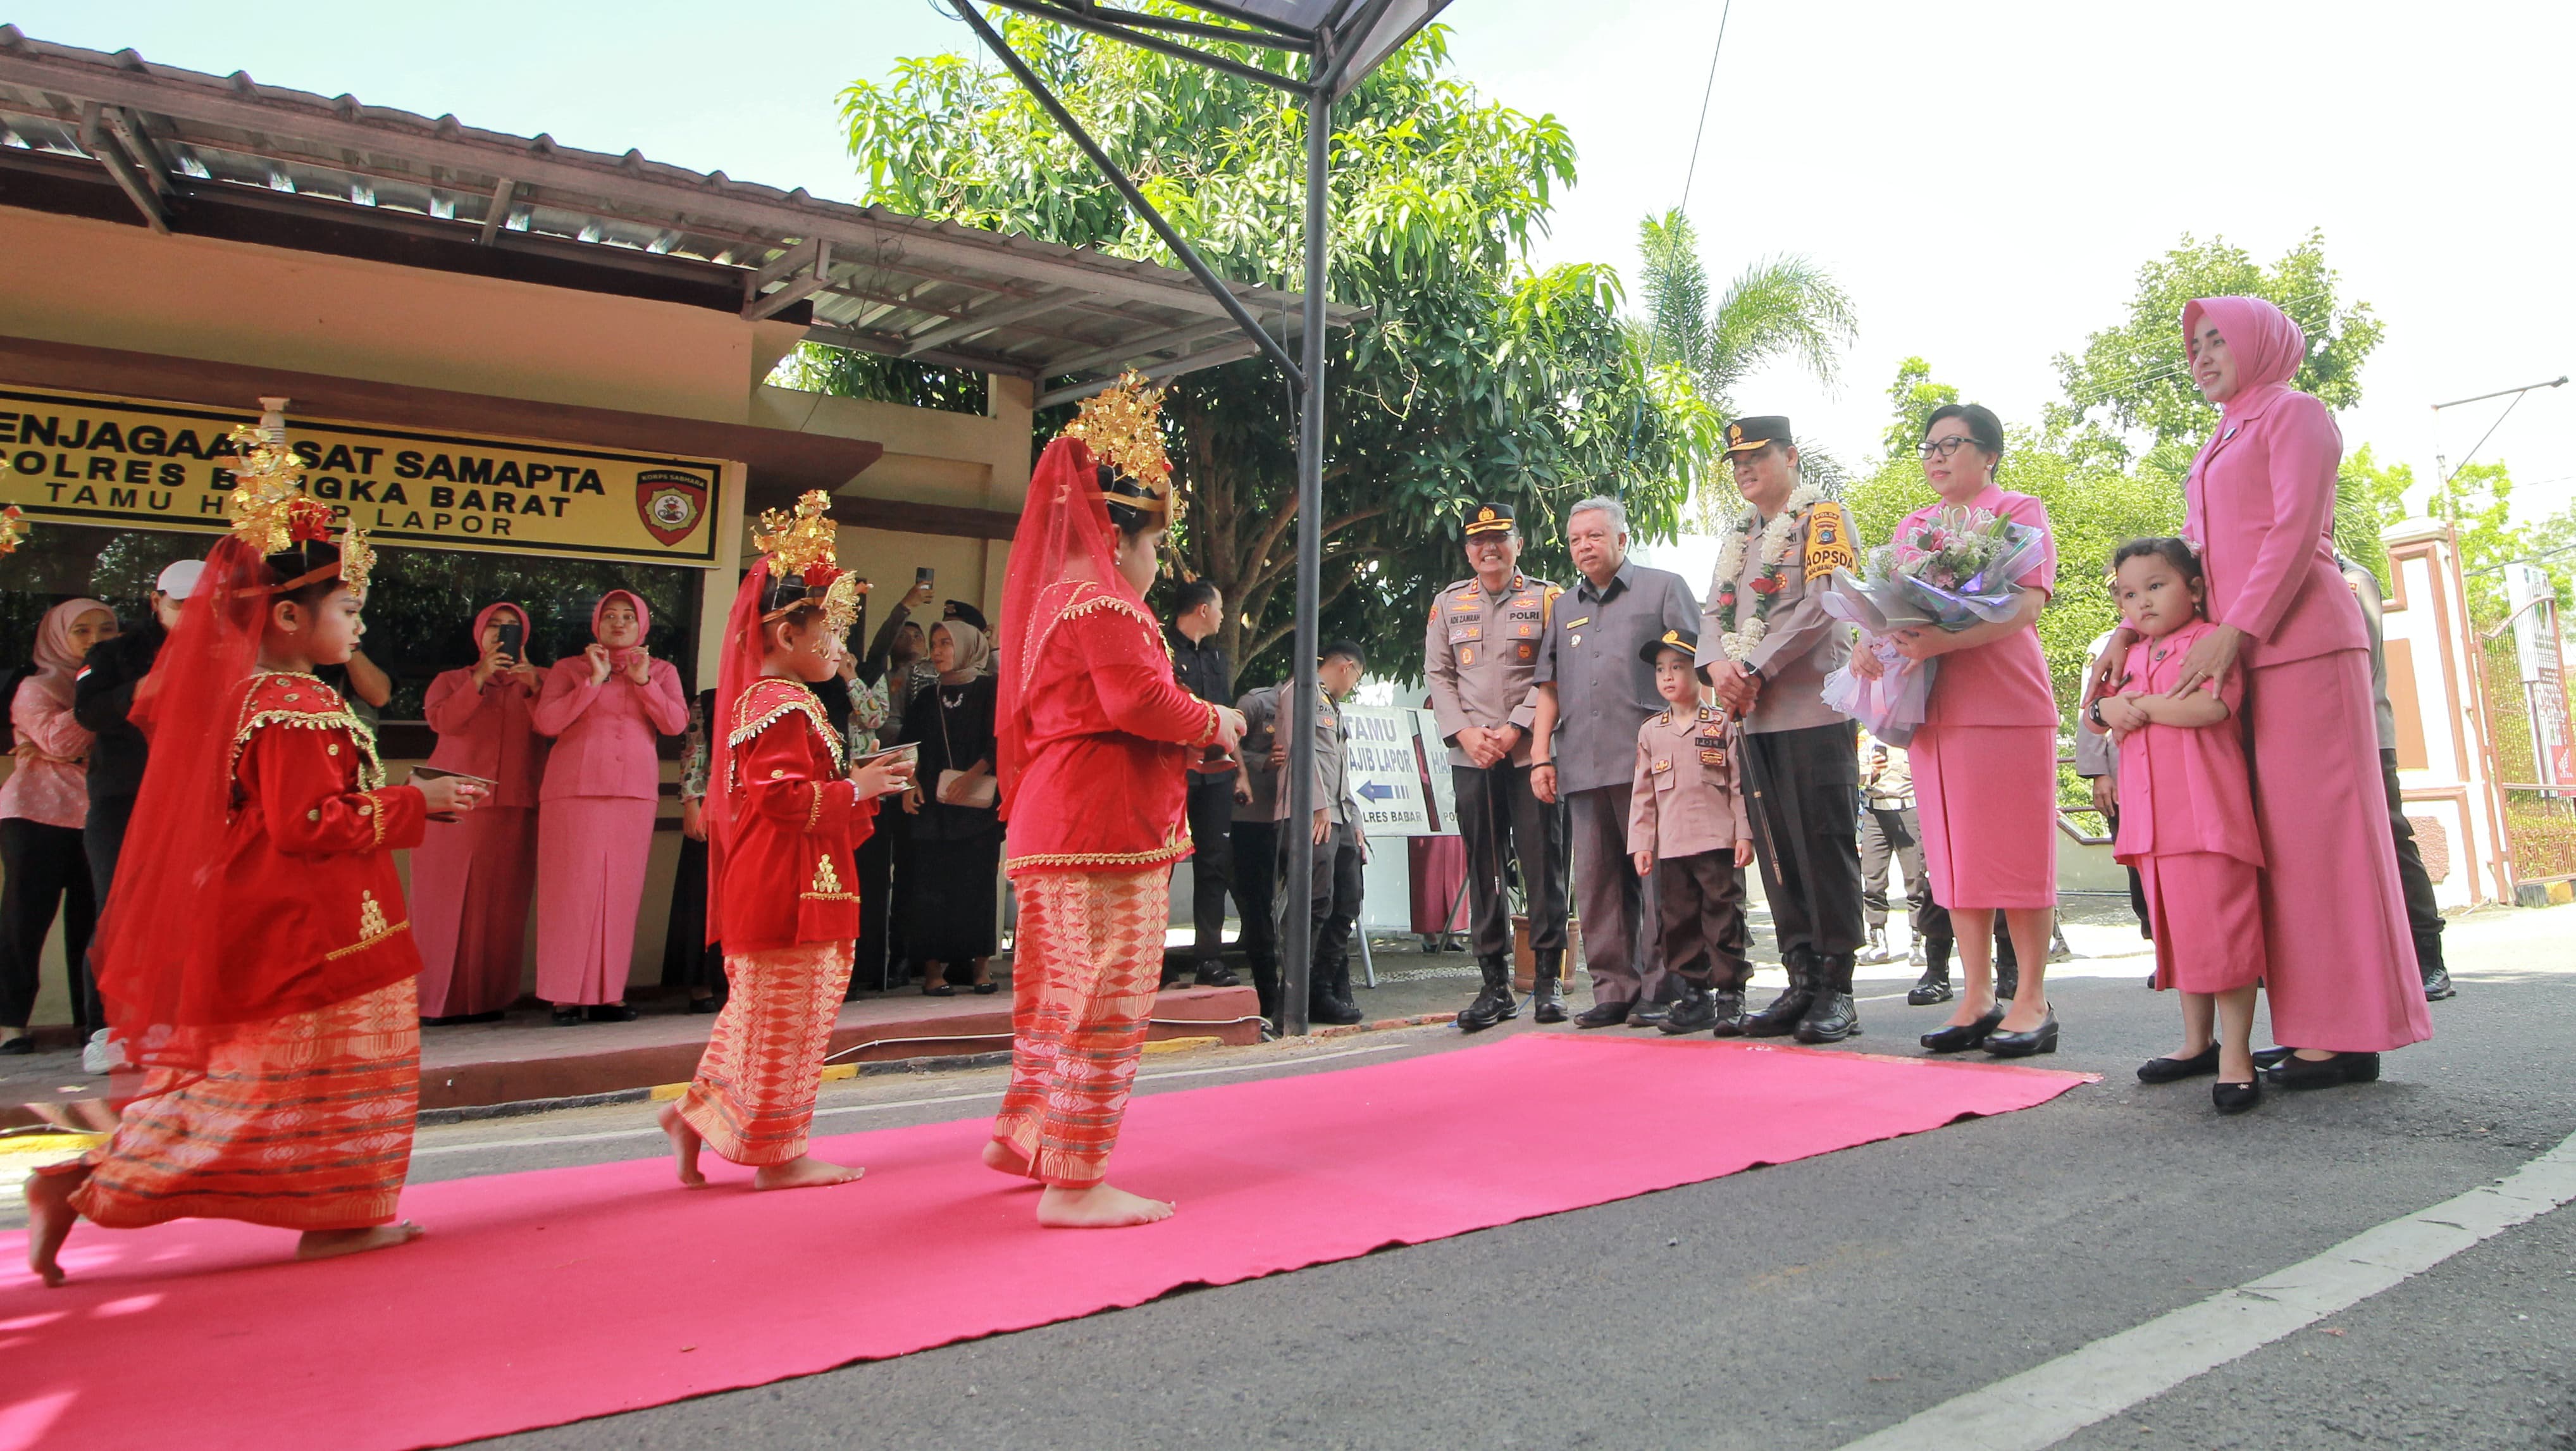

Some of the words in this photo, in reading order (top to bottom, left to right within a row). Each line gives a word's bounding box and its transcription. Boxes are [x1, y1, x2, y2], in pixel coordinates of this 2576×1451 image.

[0, 412, 255, 461] ENJAGAA
[292, 440, 383, 475] SAT
[393, 451, 605, 495] SAMAPTA
[211, 467, 407, 505] BGKA
[430, 487, 571, 517] BARAT
[670, 474, 704, 487] SABHARA
[46, 482, 172, 510] TAMU
[377, 508, 512, 536] LAPOR
[1510, 612, 1539, 620] POLRI
[1344, 716, 1397, 743] TAMU
[1348, 747, 1375, 772] AJIB
[1376, 747, 1413, 773] LAPOR
[1361, 811, 1388, 823] LRES
[1391, 811, 1423, 823] BABAR
